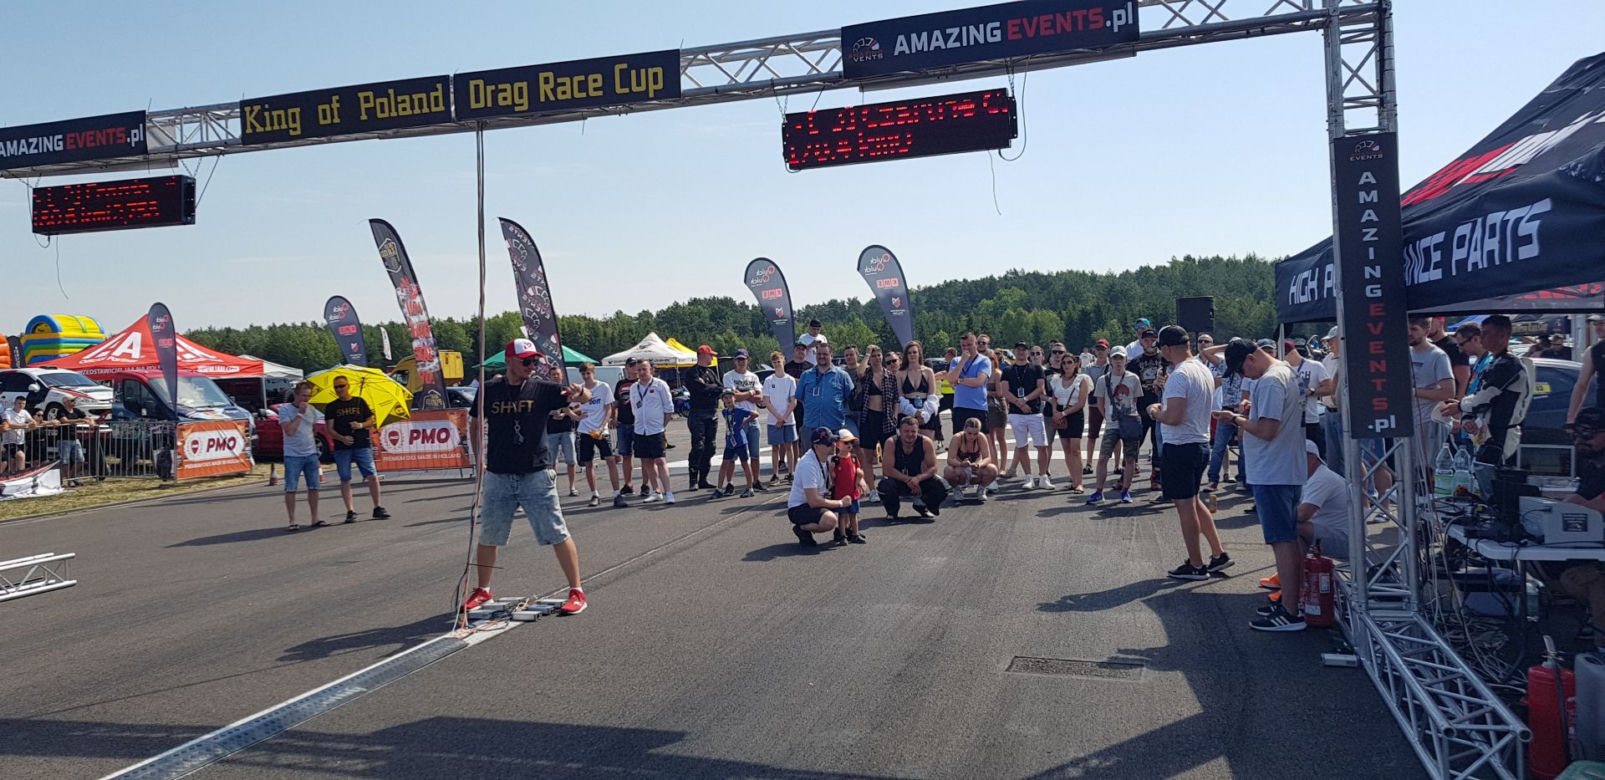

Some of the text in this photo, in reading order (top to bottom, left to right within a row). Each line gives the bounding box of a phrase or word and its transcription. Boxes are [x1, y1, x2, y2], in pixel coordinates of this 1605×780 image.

[893, 1, 1134, 56] AMAZING EVENTS.pl
[244, 83, 446, 136] King of Poland
[469, 63, 664, 112] Drag Race Cup
[0, 123, 144, 157] AMAZING EVENTS.pl
[1289, 267, 1319, 305] HIGH
[1452, 198, 1552, 276] PARTS
[206, 436, 237, 453] PMO
[408, 427, 451, 446] PMO
